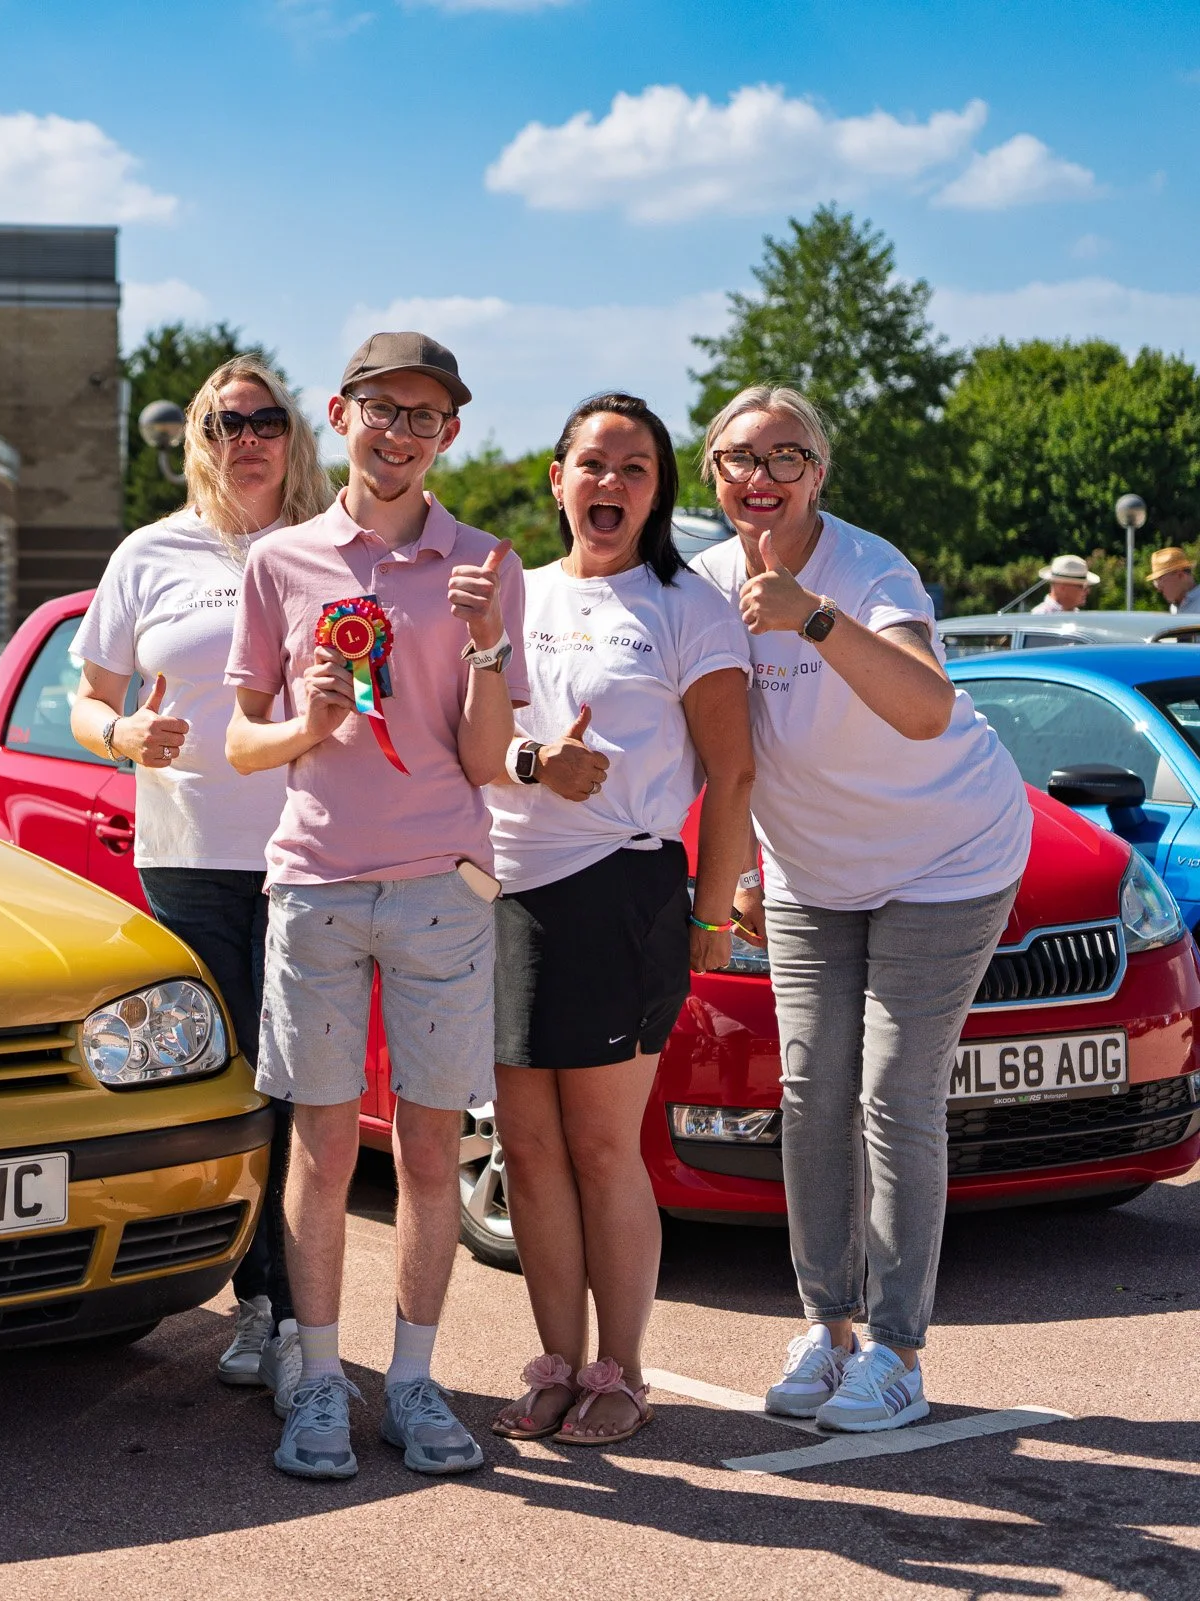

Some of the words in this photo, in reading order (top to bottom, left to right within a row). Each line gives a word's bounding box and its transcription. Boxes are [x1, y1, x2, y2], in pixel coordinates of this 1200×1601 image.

[473, 654, 493, 665] Club
[950, 1045, 1044, 1094] ML68
[1056, 1038, 1121, 1086] AOG
